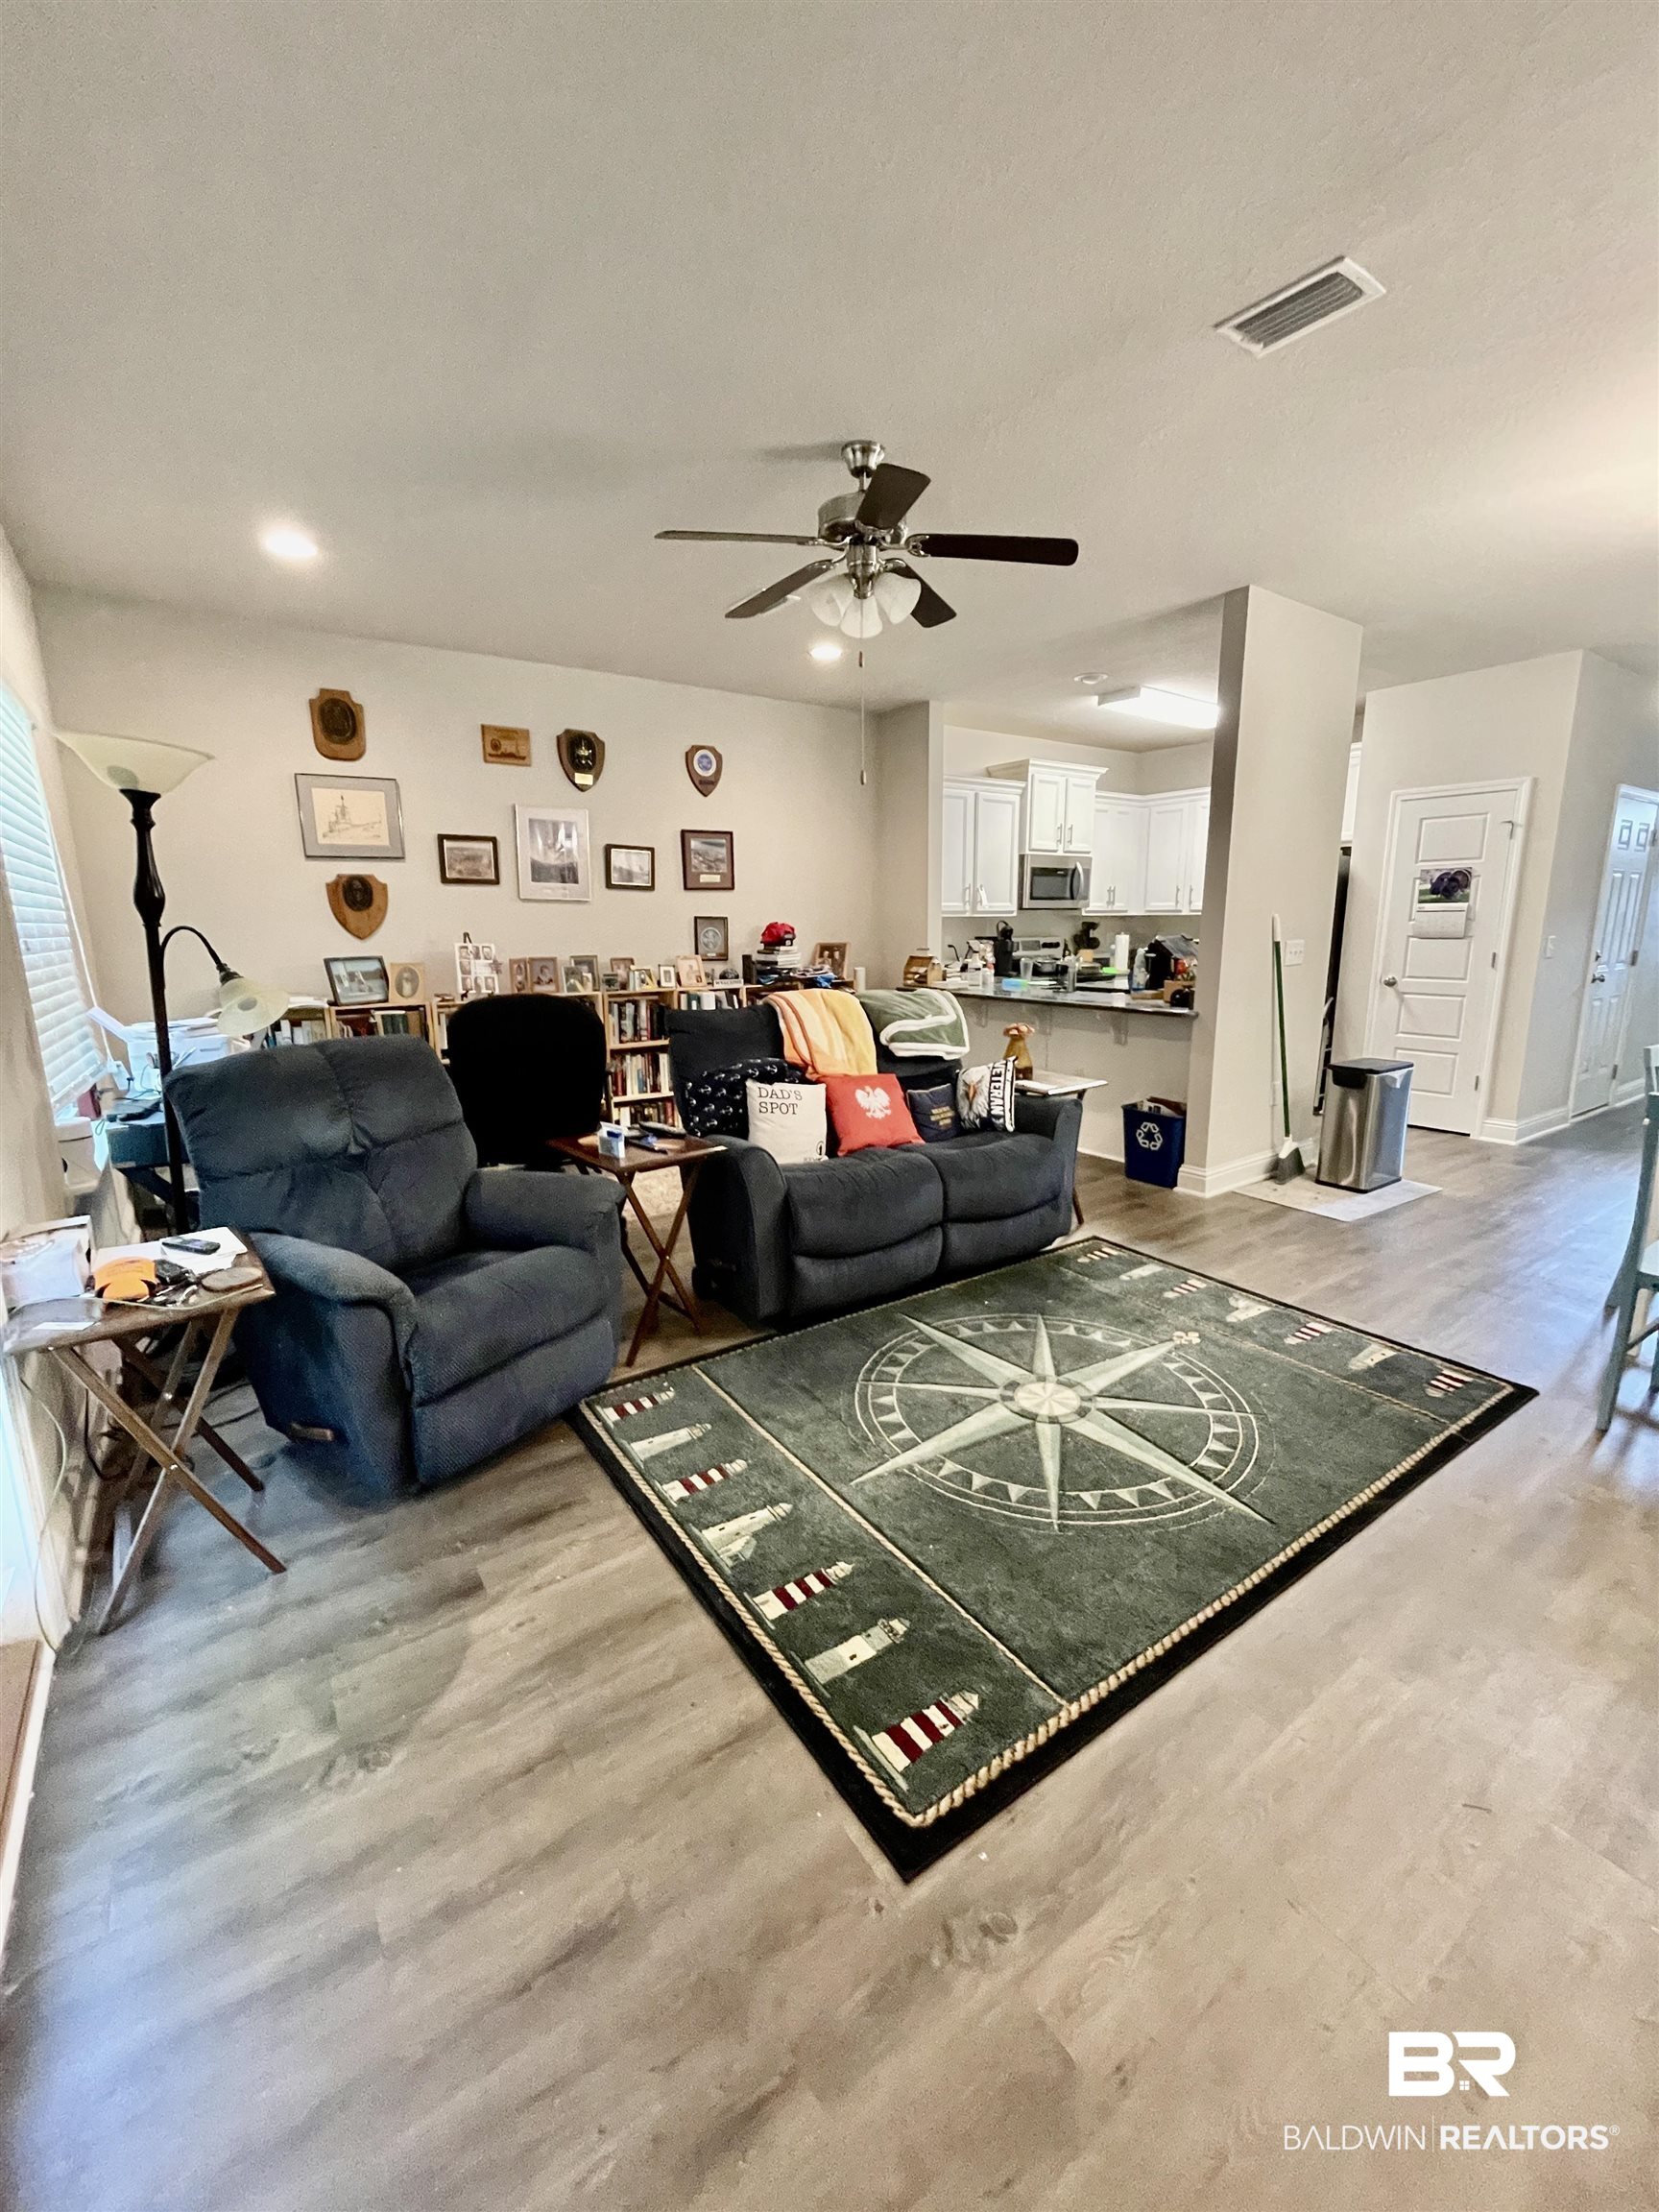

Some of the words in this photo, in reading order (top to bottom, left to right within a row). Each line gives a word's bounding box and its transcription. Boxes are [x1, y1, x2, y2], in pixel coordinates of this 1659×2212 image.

[757, 1087, 803, 1101] DAD'S
[990, 1061, 1006, 1115] VETERAN
[758, 1101, 798, 1115] SPOT
